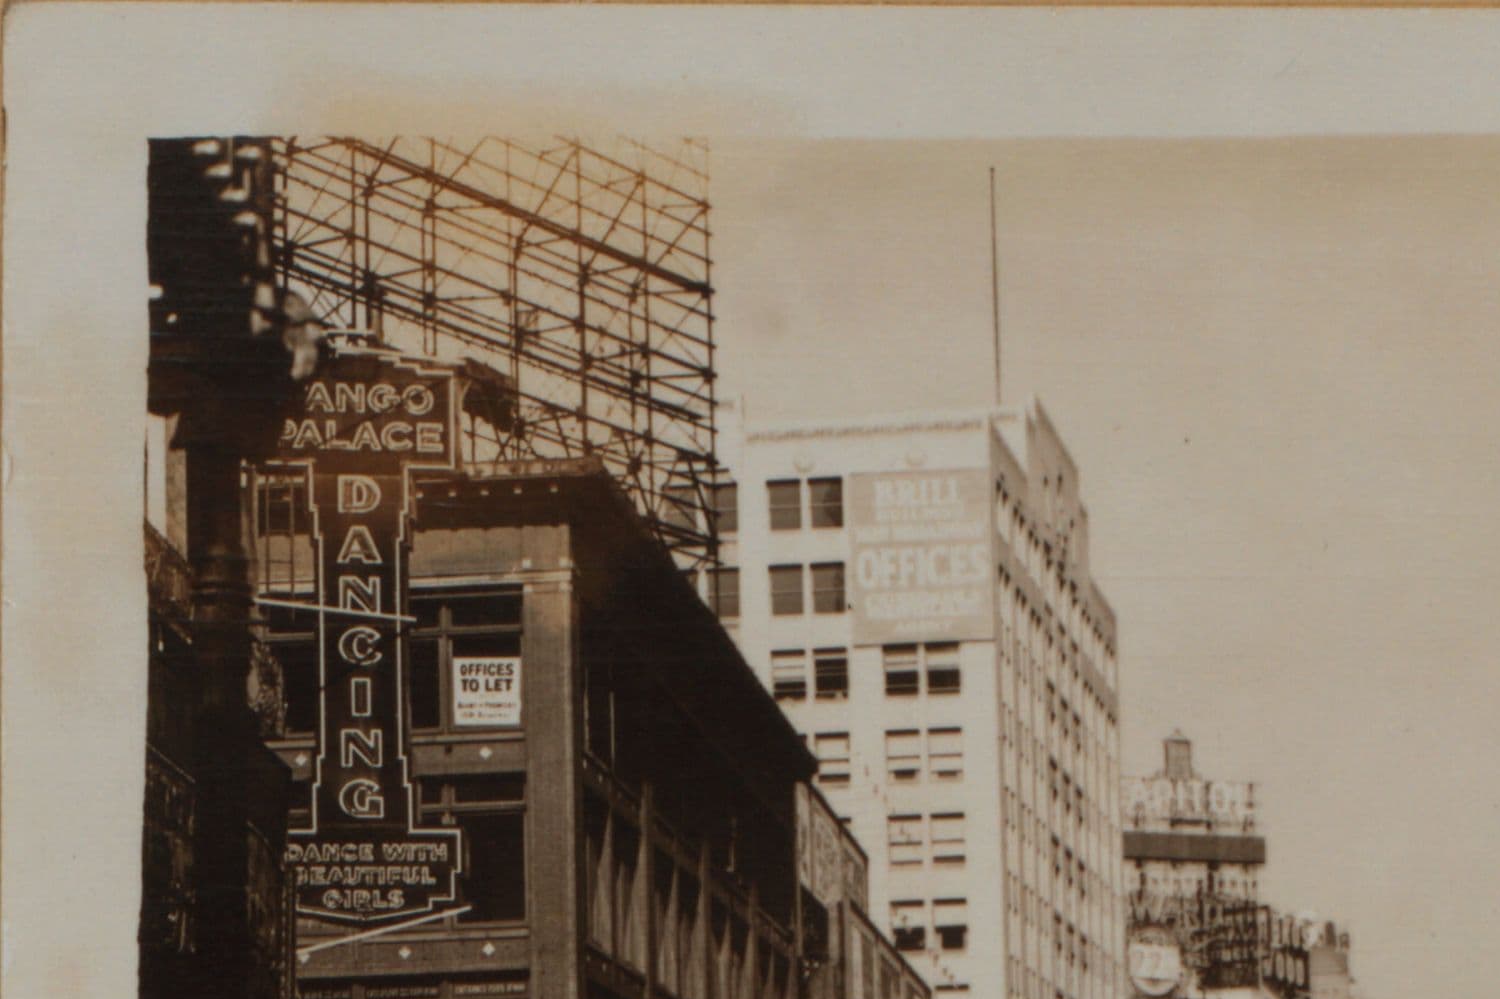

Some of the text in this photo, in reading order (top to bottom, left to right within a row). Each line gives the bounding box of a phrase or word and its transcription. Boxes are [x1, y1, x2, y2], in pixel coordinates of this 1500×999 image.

[304, 381, 435, 415] ANGO
[338, 474, 385, 818] DANCING
[460, 662, 514, 677] OFFICES
[461, 678, 513, 693] TO LET
[284, 841, 449, 864] DANCE WITH
[322, 887, 405, 909] GIRLS
